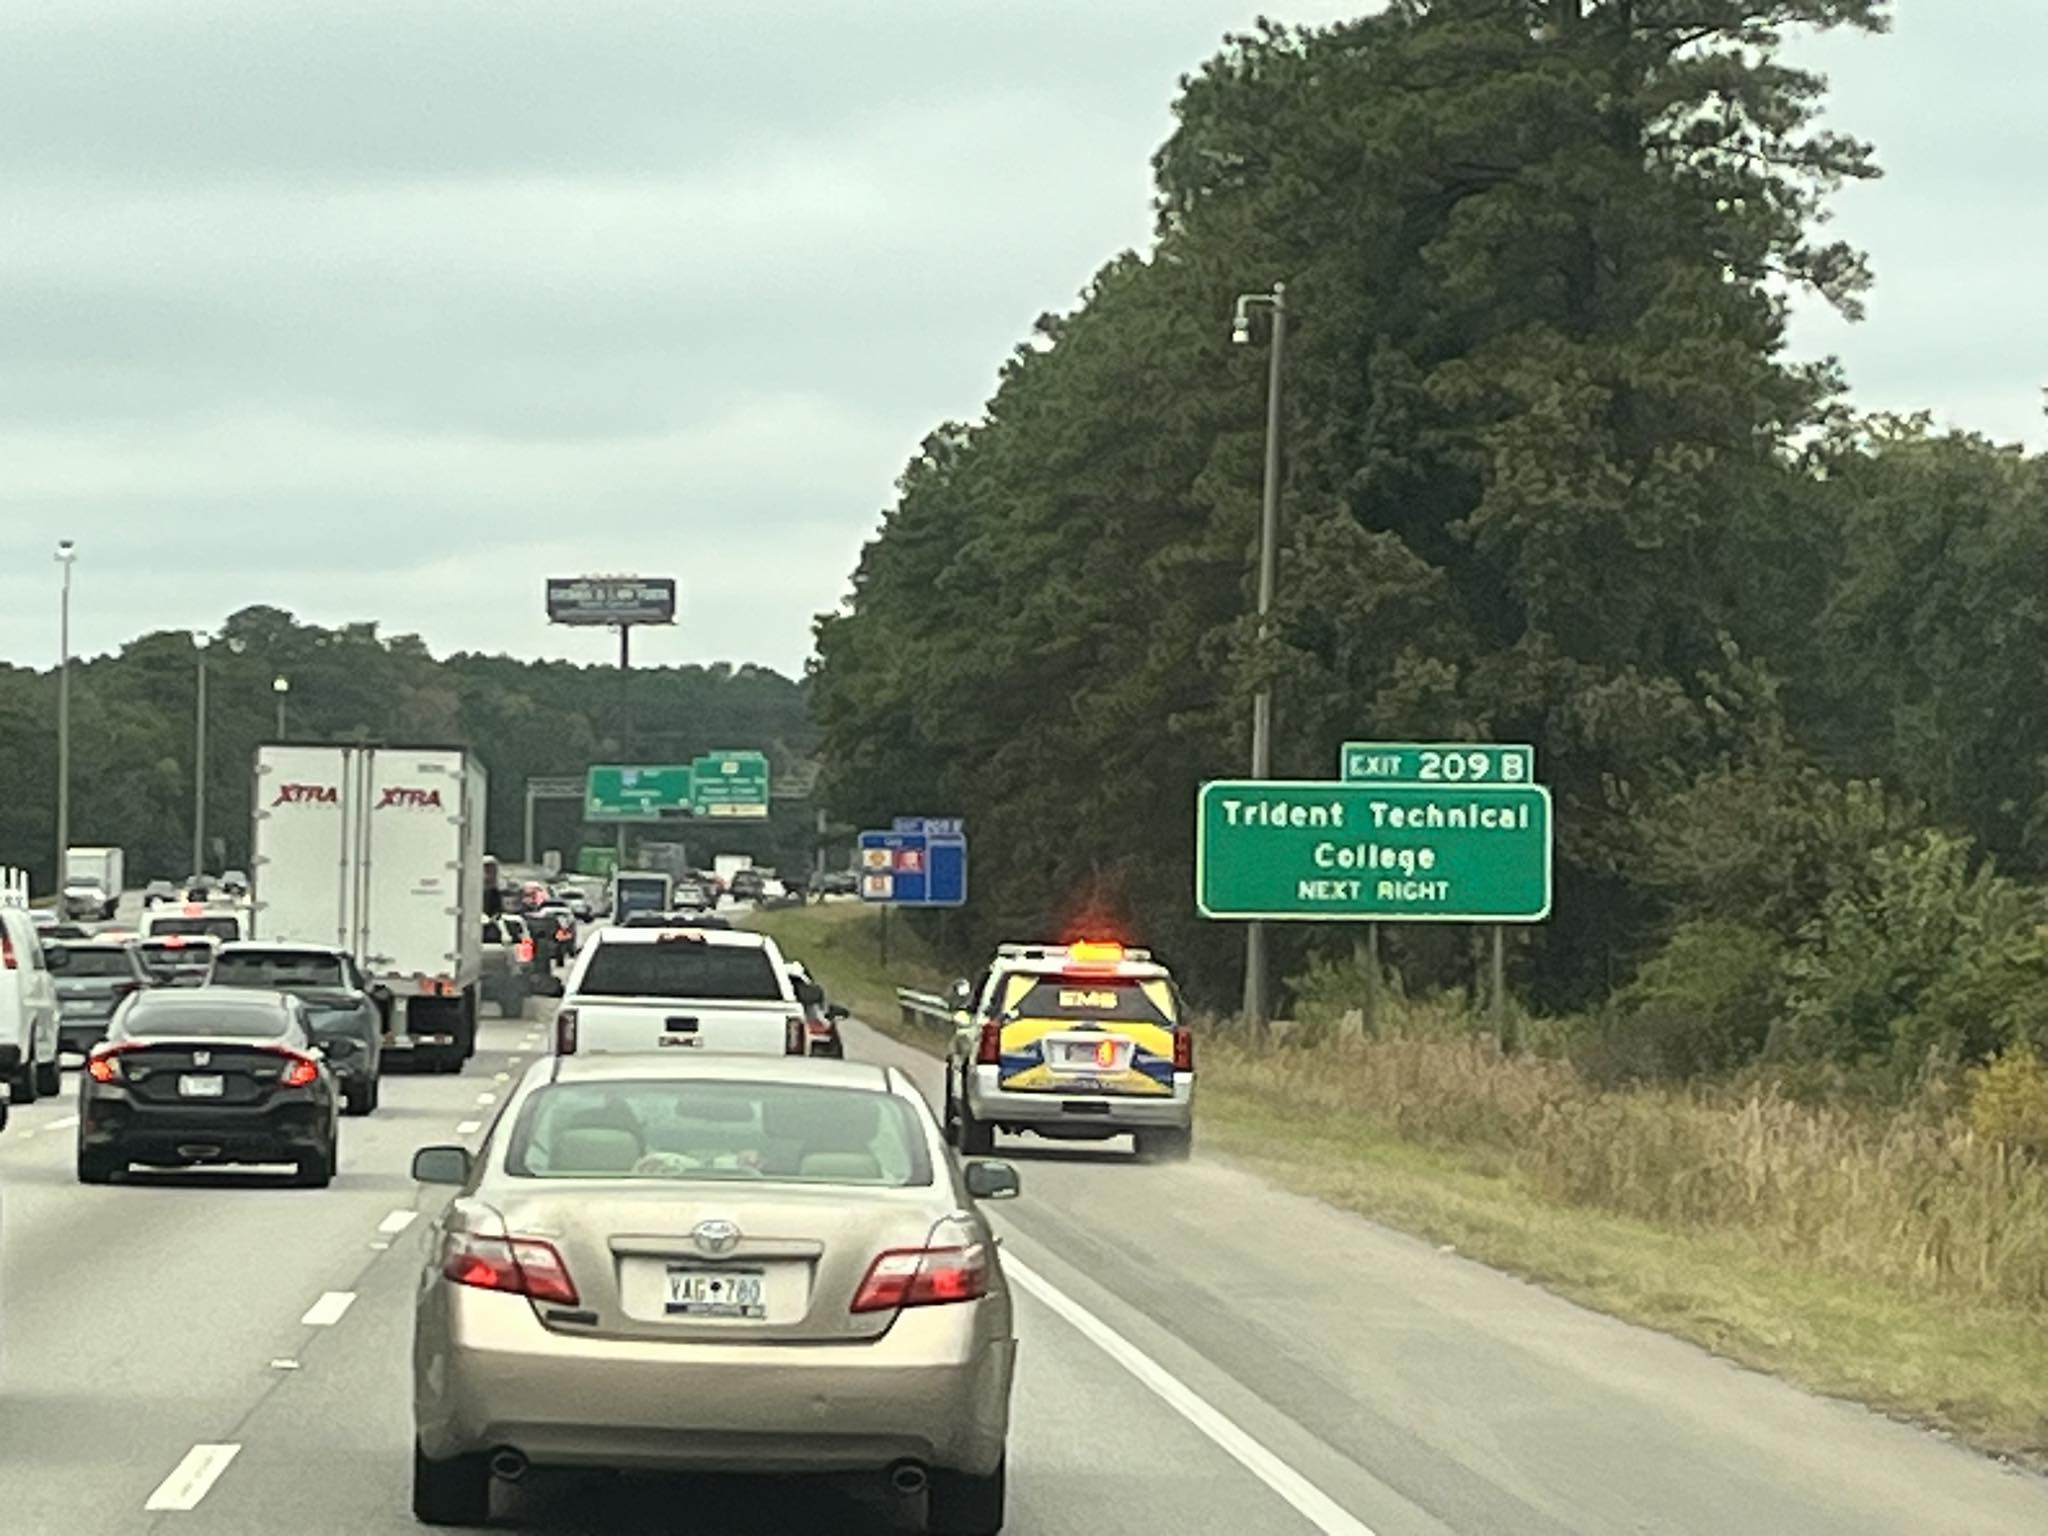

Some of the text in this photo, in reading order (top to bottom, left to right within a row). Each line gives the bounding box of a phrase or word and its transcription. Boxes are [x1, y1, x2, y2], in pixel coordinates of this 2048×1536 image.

[1350, 753, 1524, 781] EXIT 209 B
[272, 784, 337, 807] XTRA
[375, 787, 441, 810] XTRA
[1222, 801, 1528, 829] Trident Technical
[1314, 842, 1436, 876] College
[1298, 881, 1448, 901] NEXT RIGHT
[1059, 990, 1118, 1009] EMS
